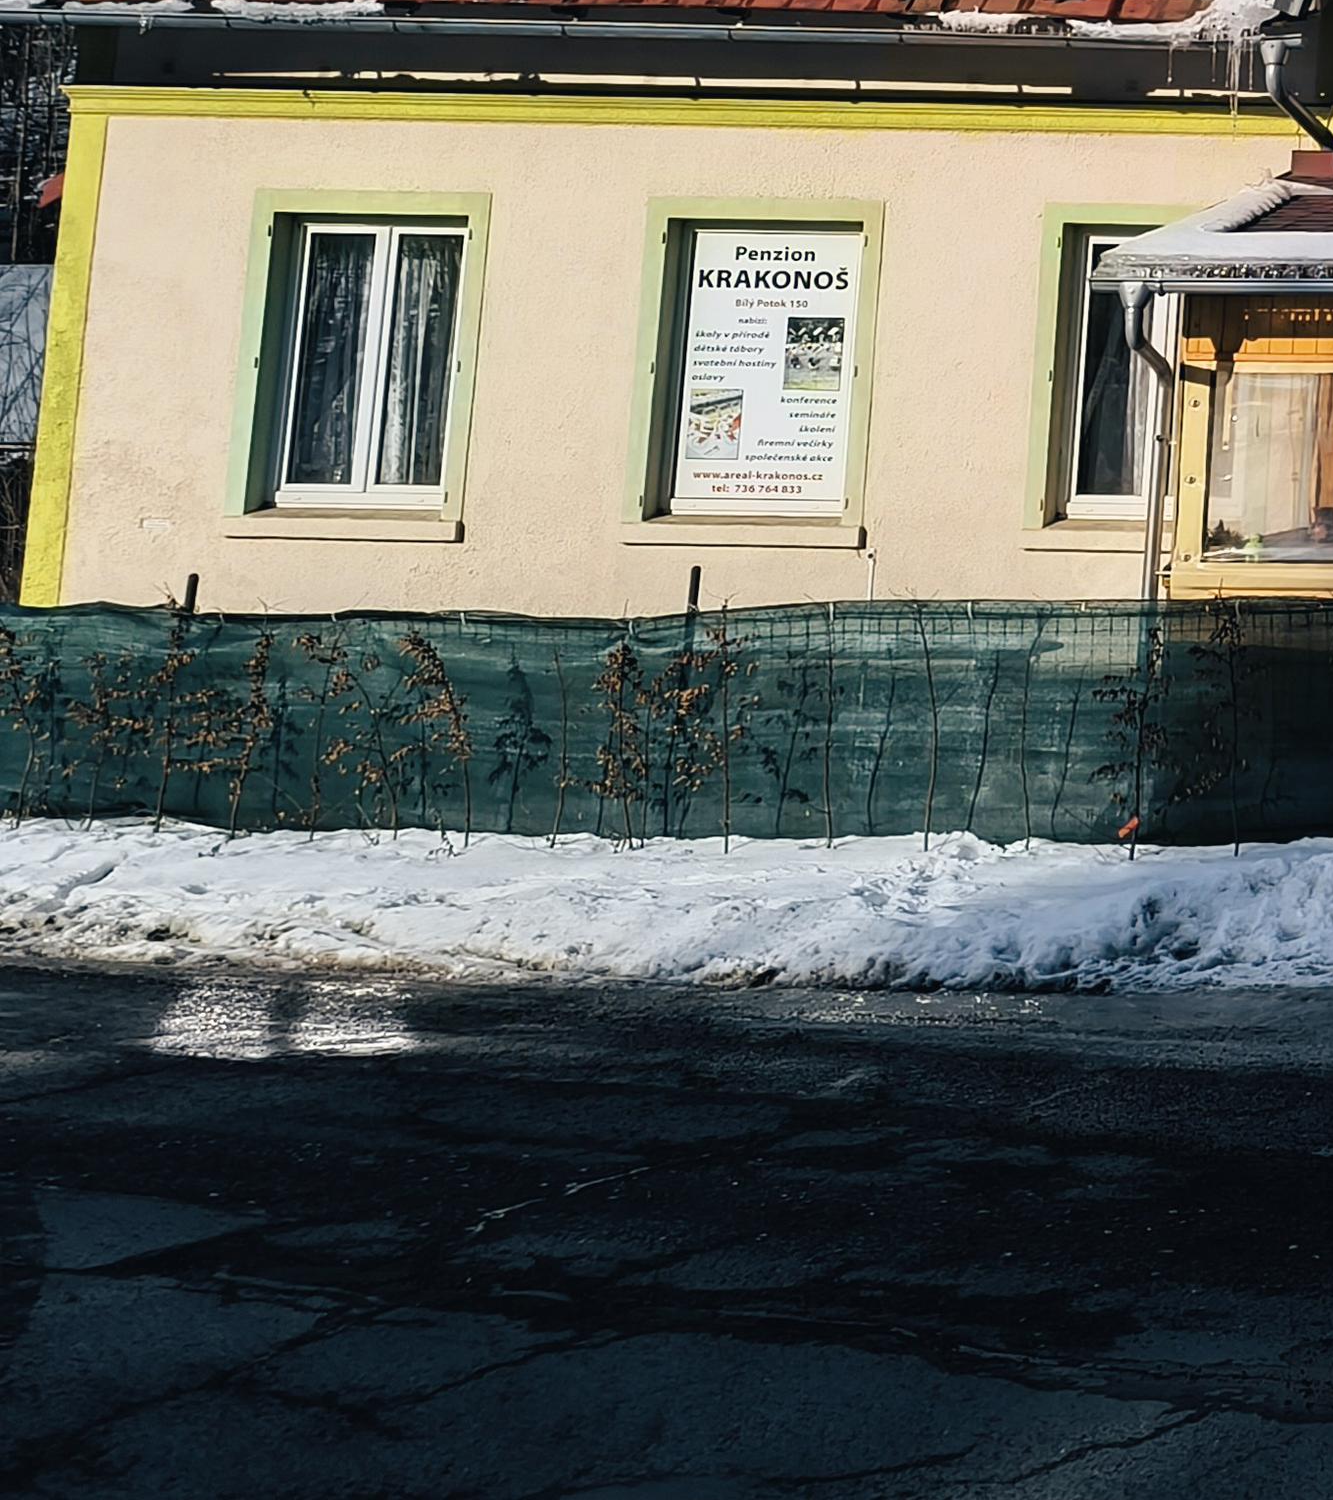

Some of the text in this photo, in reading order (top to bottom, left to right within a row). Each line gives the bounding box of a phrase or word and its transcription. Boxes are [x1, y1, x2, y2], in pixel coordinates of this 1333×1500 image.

[735, 245, 816, 262] Penzion
[698, 266, 849, 291] KRAKONOŠ
[756, 298, 787, 308] Potok
[789, 299, 809, 309] 150
[691, 372, 726, 383] oslavy
[780, 395, 838, 405] konference
[756, 438, 796, 447] firemní
[809, 454, 834, 463] akce
[692, 469, 824, 481] www.areal-krakonos.cz
[711, 483, 803, 495] tel: 736 764 833
